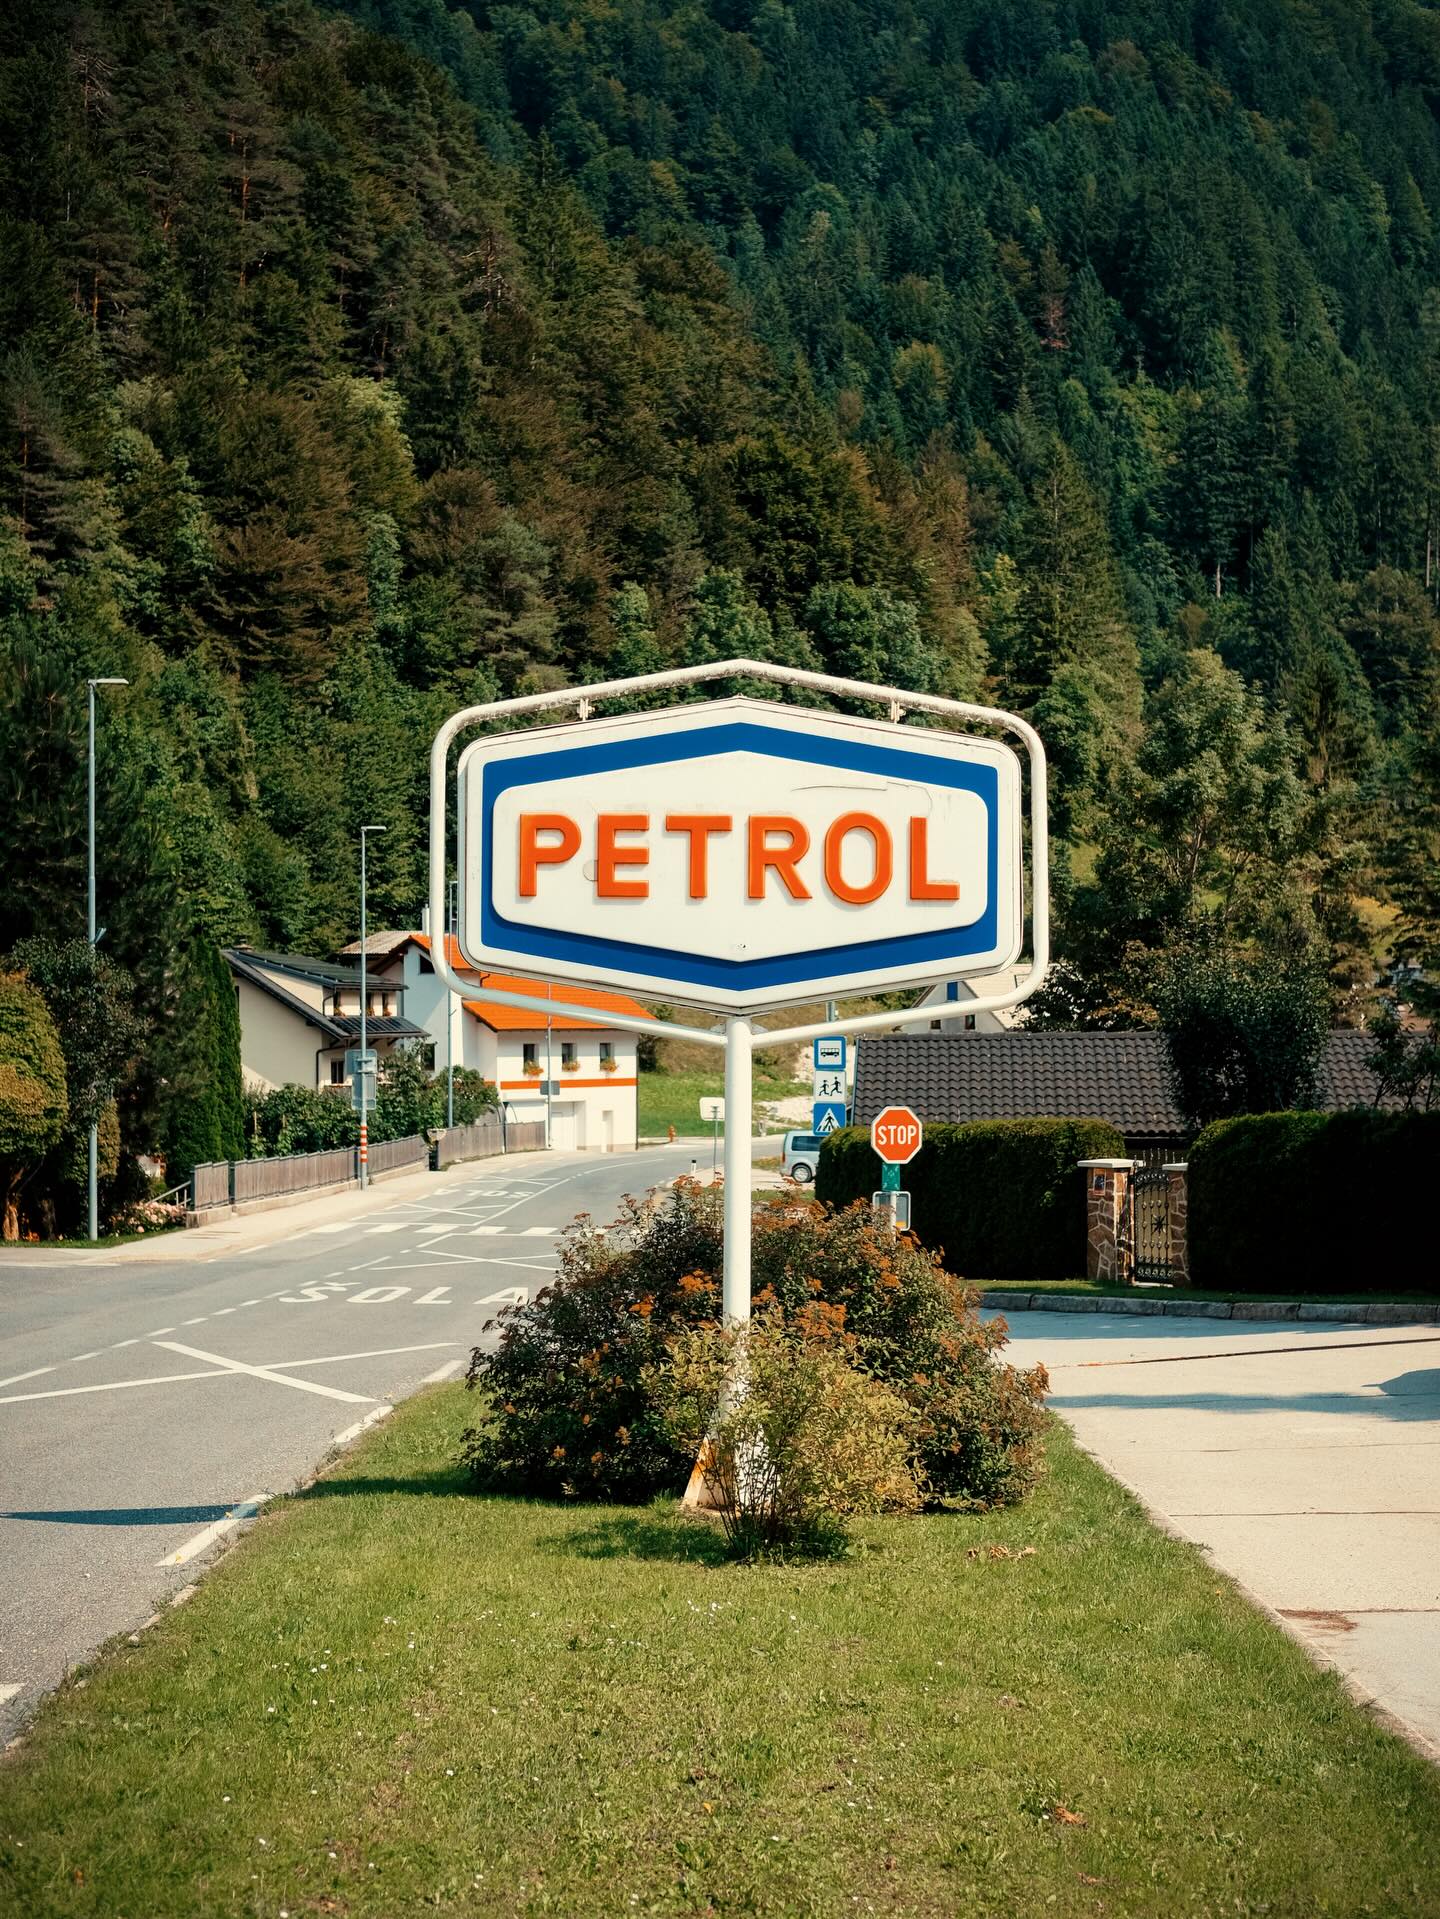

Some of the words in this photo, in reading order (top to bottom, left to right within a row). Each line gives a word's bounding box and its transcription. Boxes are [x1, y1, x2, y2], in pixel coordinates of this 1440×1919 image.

[519, 811, 960, 904] PETROL
[878, 1125, 917, 1145] STOP
[279, 1281, 529, 1305] ŠOLA
